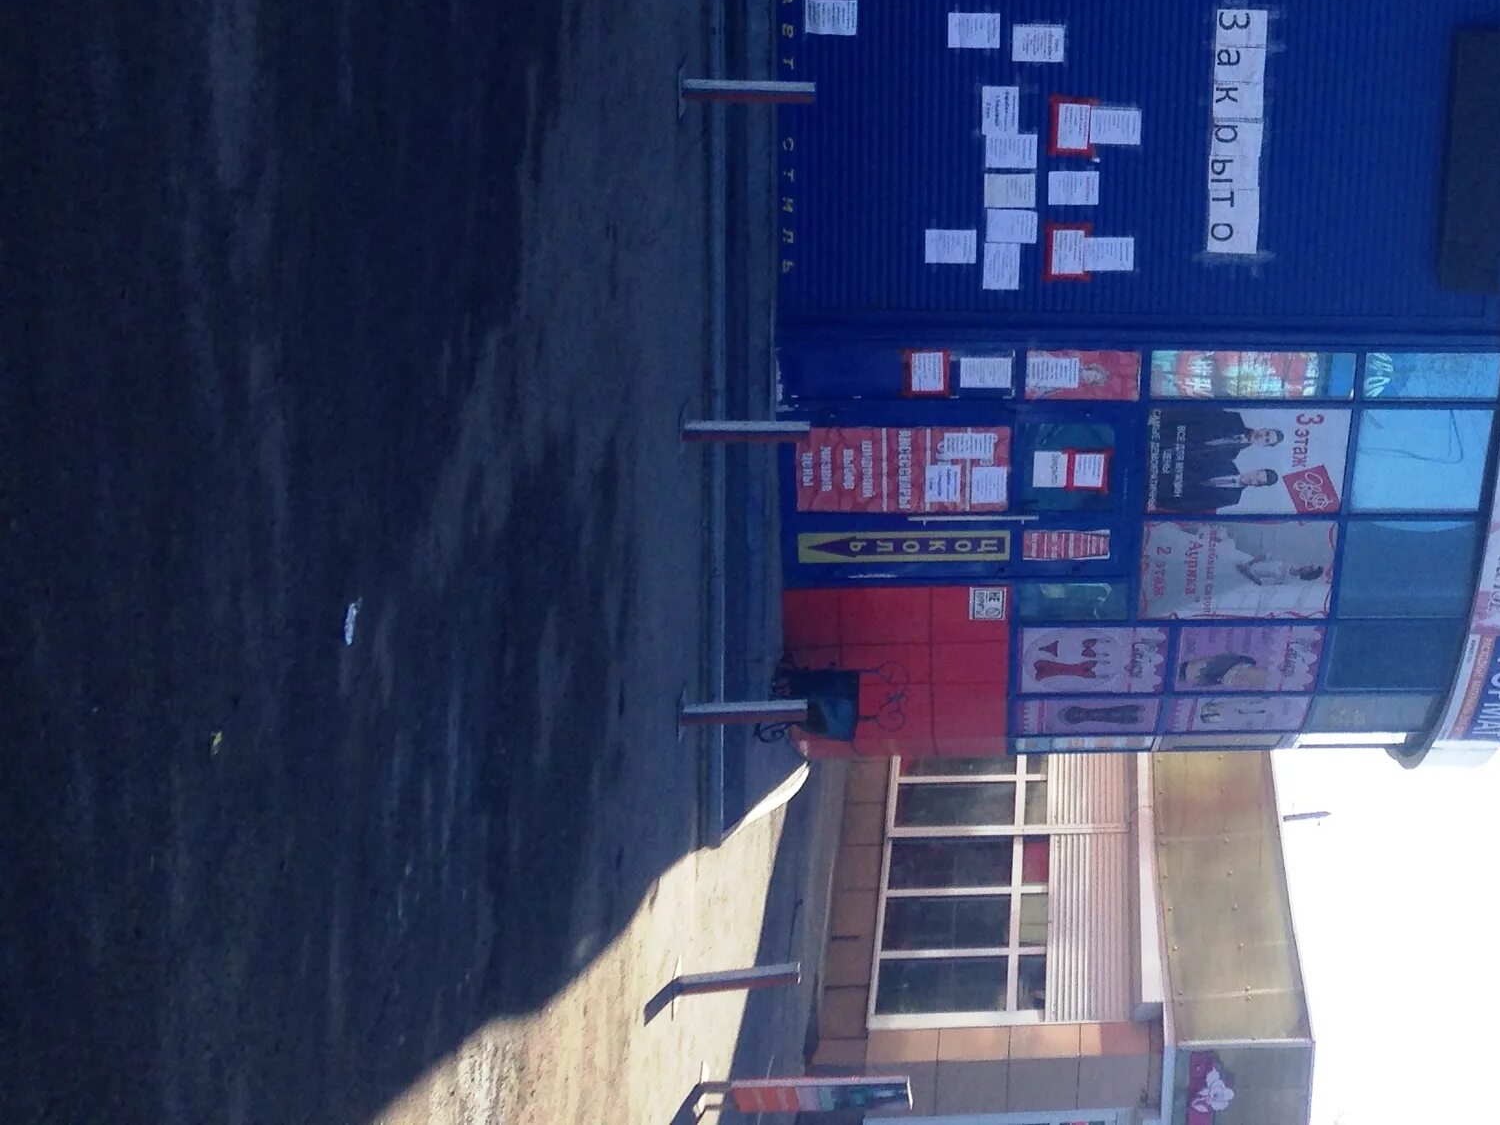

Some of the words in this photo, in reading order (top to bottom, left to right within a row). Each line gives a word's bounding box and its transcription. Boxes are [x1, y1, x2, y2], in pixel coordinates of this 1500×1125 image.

[1209, 11, 1252, 242] Закрыто
[1296, 413, 1325, 426] 3
[1291, 429, 1310, 468] этаж
[848, 538, 997, 554] ЦОКОЛЬ
[1156, 546, 1171, 556] 2
